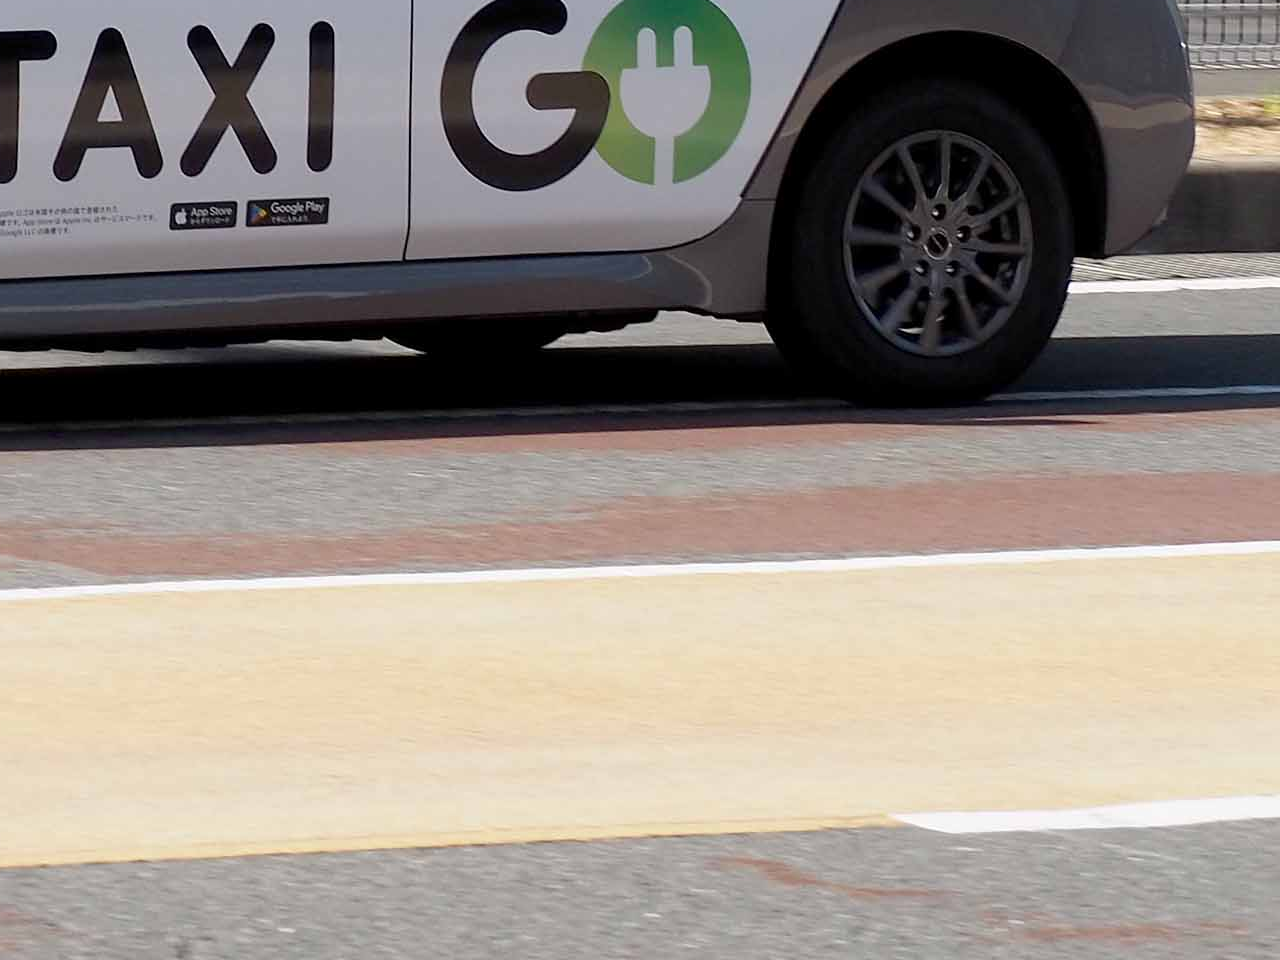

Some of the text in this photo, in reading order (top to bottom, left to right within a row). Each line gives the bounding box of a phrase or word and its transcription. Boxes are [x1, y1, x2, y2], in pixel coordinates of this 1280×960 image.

[190, 206, 233, 218] App Store
[270, 200, 326, 215] Google Play
